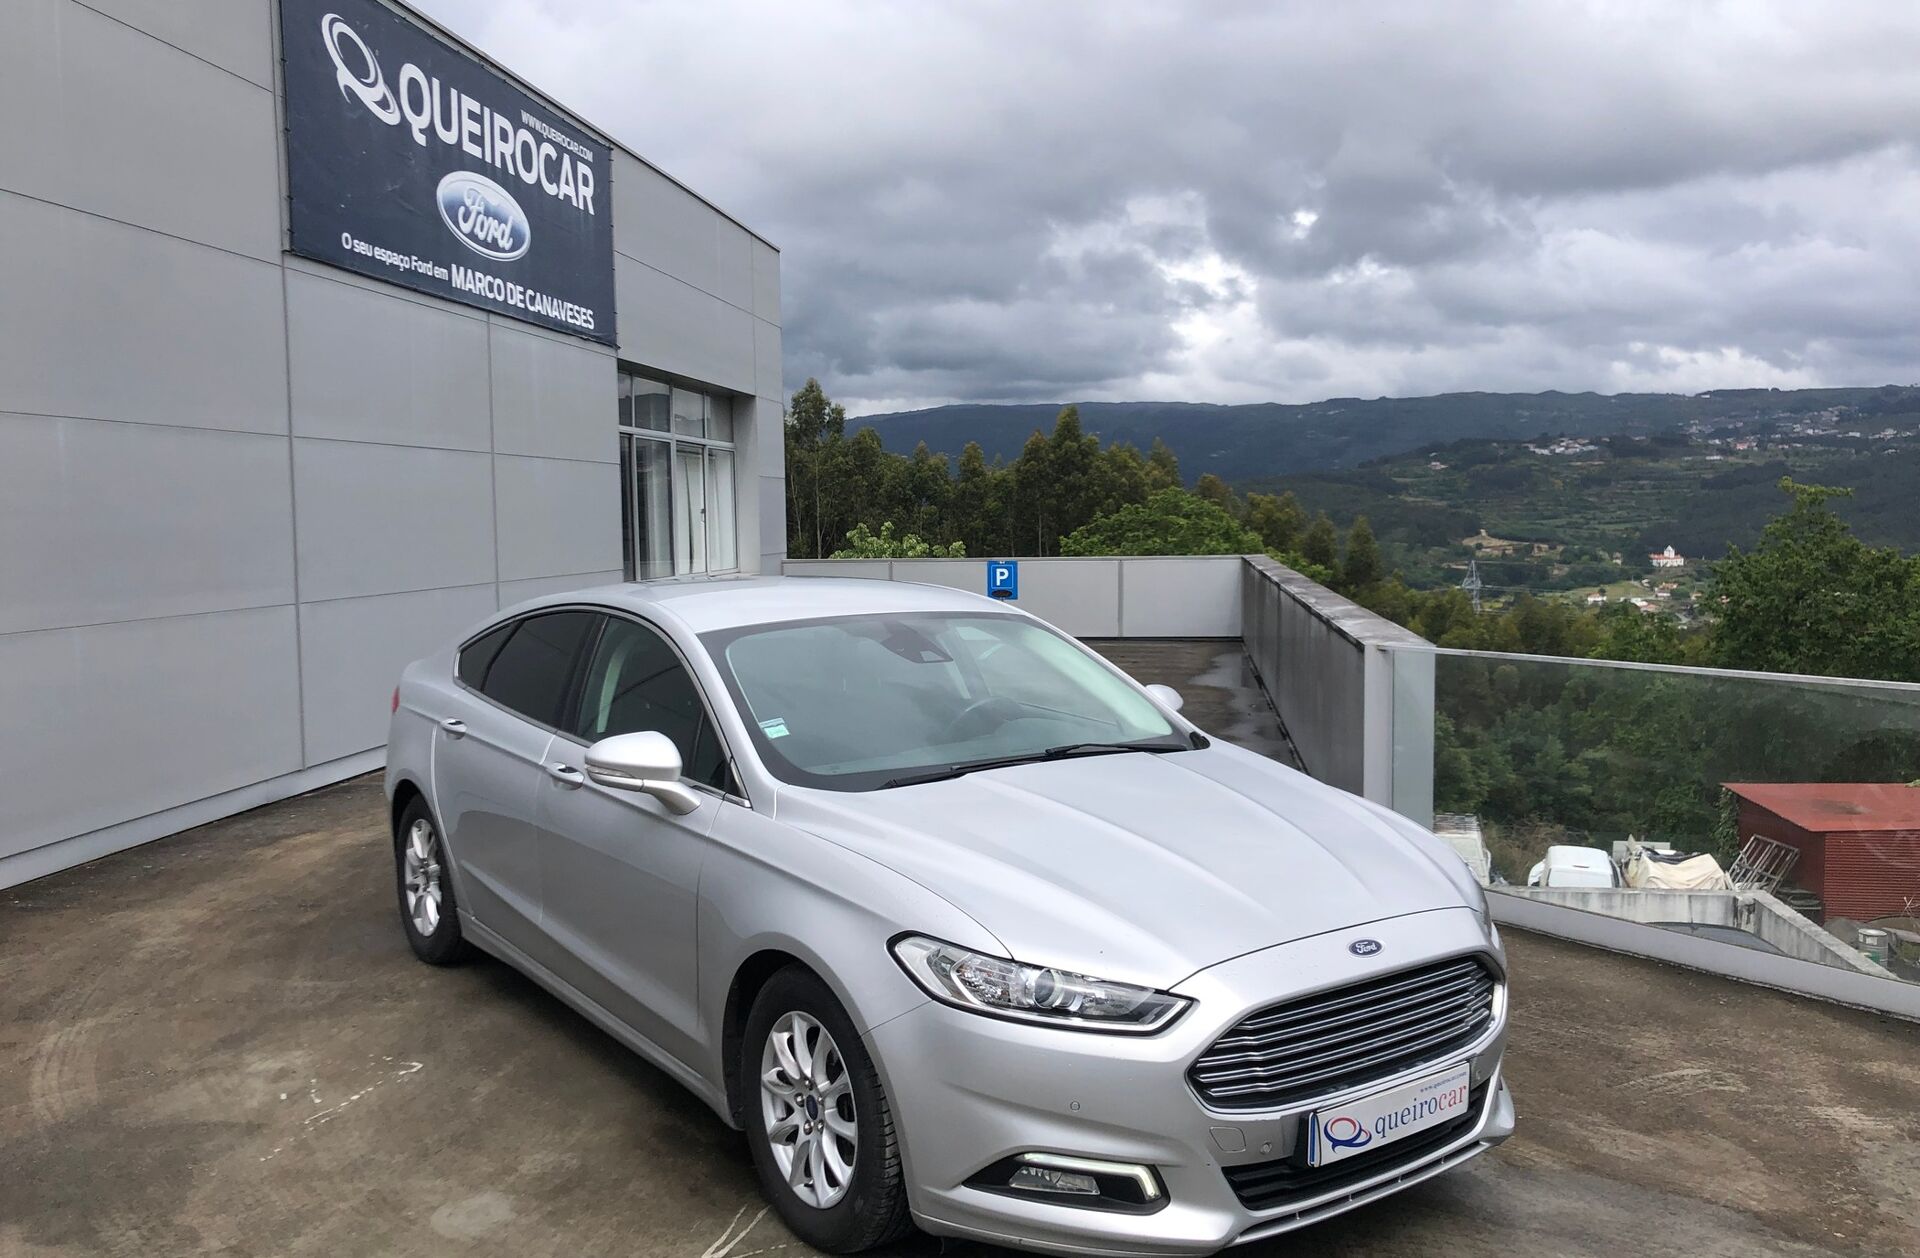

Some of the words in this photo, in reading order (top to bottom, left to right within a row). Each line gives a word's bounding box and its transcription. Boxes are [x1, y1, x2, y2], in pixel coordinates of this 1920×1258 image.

[400, 62, 595, 216] QUEIROCAR
[457, 187, 513, 251] Ford
[341, 232, 352, 250] O
[353, 239, 373, 257] seu
[374, 246, 410, 272] espaço
[411, 255, 433, 276] Ford
[433, 266, 449, 281] em
[451, 263, 506, 302] MARCO
[506, 281, 526, 309] DE
[525, 289, 595, 330] CANAVESES
[995, 567, 1009, 586] P
[1355, 941, 1378, 954] Ford
[1375, 1085, 1467, 1139] queirocar
